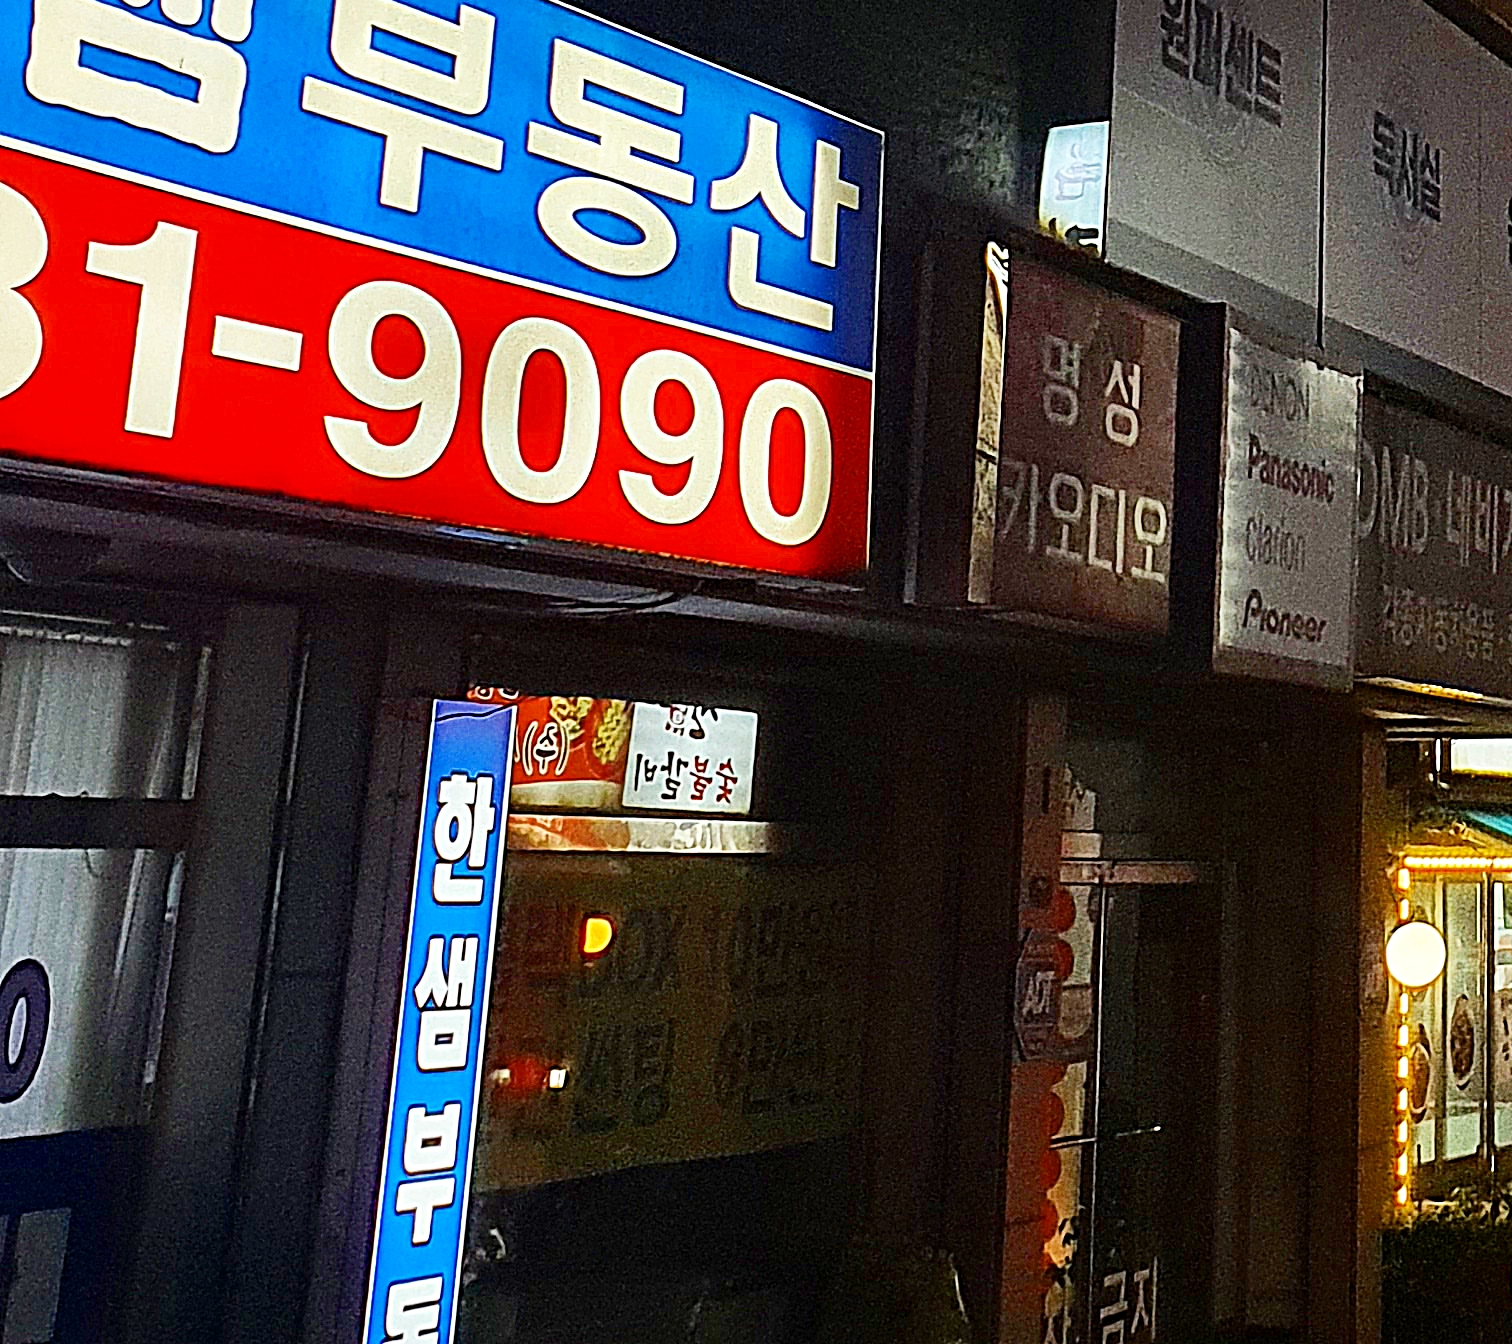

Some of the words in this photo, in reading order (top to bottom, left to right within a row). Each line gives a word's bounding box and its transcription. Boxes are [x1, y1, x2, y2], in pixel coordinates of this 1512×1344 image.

[1372, 110, 1441, 223] 독서실
[1247, 432, 1336, 503] Panasonic
[1000, 458, 1170, 585] 카오디오
[1242, 589, 1327, 644] Pioneer
